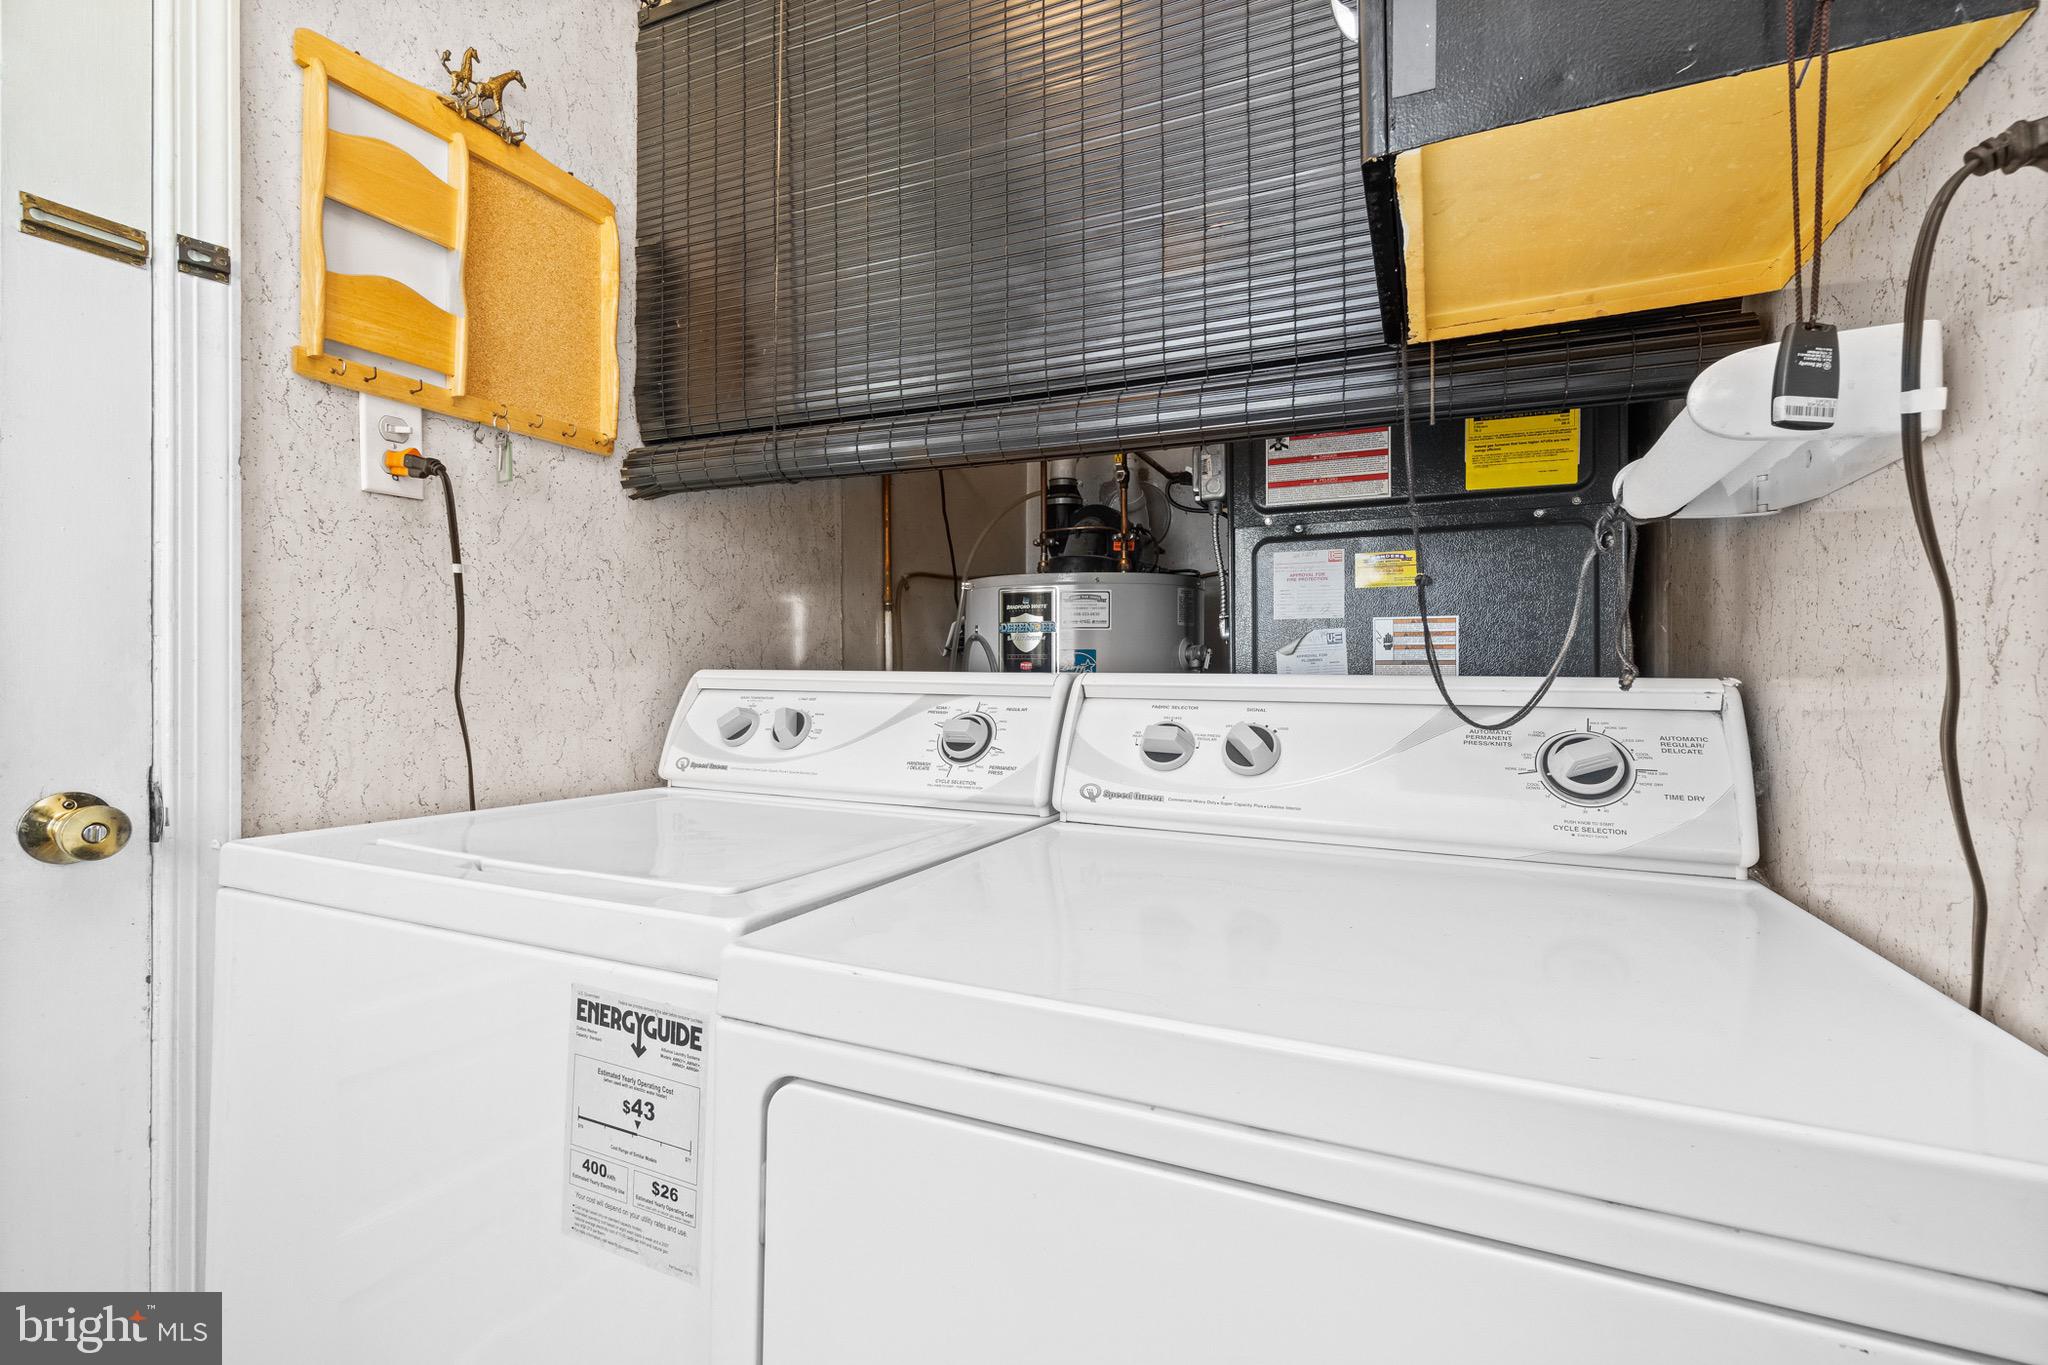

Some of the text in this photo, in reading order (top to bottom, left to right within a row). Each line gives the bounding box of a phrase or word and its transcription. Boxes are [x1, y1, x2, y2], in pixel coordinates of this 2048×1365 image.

[1103, 790, 1133, 799] Speed
[1135, 793, 1165, 802] Queen
[1553, 824, 1627, 835] CYCLE SELECTION
[577, 998, 702, 1052] ENERGYGUIDE
[597, 1068, 674, 1095] Estimated Yearly Operating Cost
[622, 1098, 655, 1121] $43
[572, 1172, 589, 1182] Estimated
[589, 1177, 600, 1186] Yearly
[582, 1159, 607, 1177] 400
[651, 1181, 678, 1202] $26
[576, 1192, 585, 1200] Your
[586, 1196, 595, 1204] cost
[604, 1201, 622, 1214] depend
[629, 1211, 640, 1220] your
[640, 1214, 653, 1226] utility
[654, 1220, 666, 1230] rates
[667, 1225, 677, 1234] and
[635, 1194, 654, 1205] Estimated
[654, 1201, 665, 1210] Yearly
[665, 1204, 684, 1217] Operating
[685, 1211, 694, 1219] Cost
